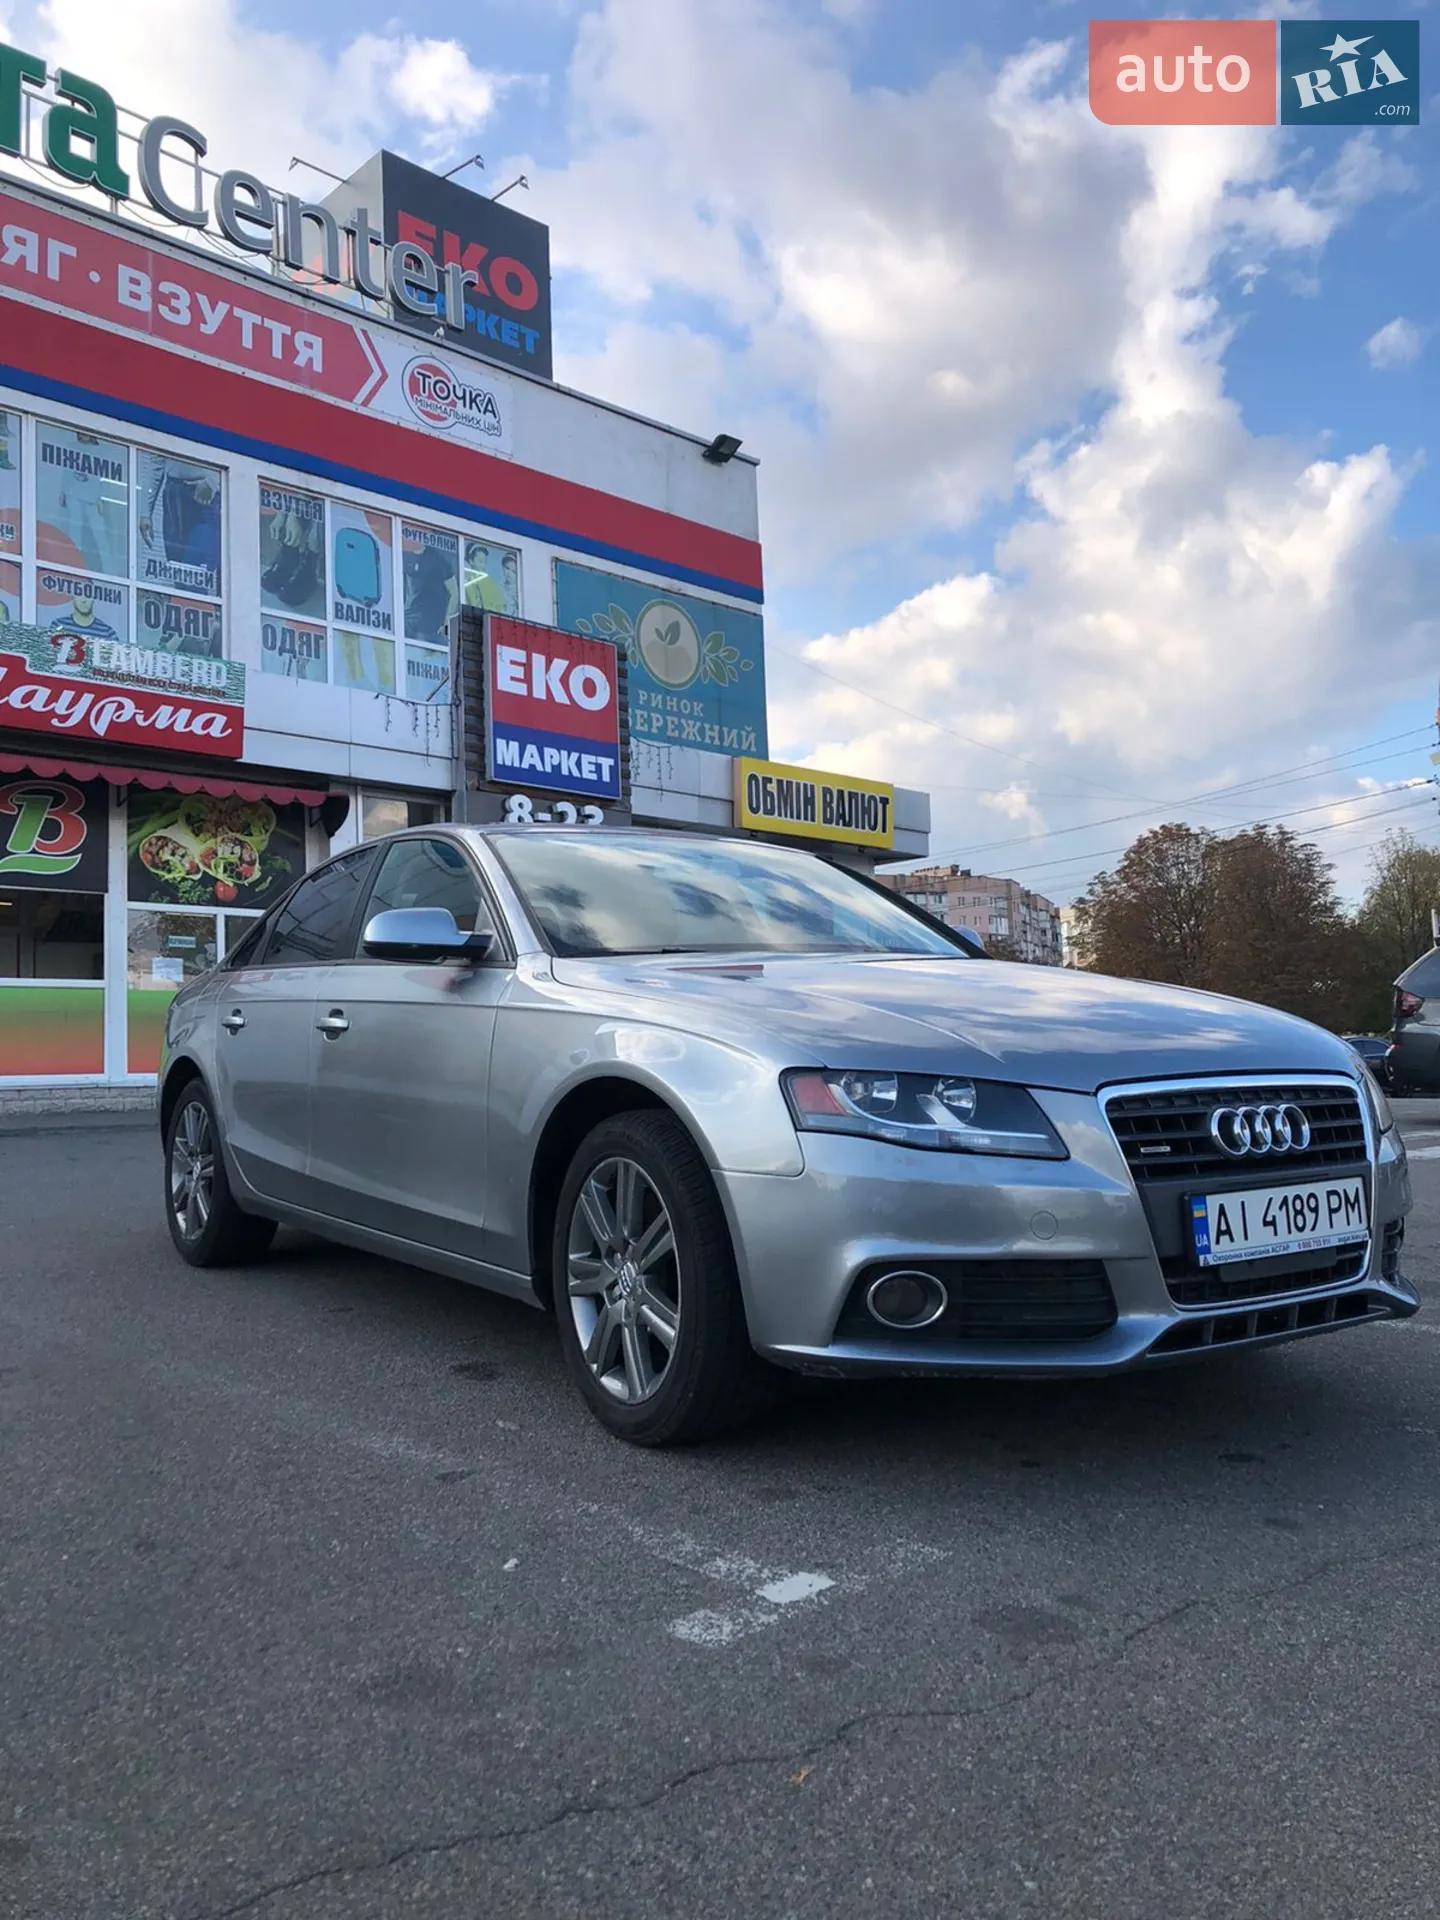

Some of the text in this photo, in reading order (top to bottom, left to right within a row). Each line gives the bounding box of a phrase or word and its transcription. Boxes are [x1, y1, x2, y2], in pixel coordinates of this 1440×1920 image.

[397, 210, 539, 311] ЕКО
[117, 263, 324, 374] ВЗУТТЯ
[414, 396, 482, 427] МІНІМАЛЬНИХ
[416, 370, 498, 420] ТОЧКА
[41, 441, 123, 482] ПІЖАМИ
[260, 487, 324, 521] ВЗУТТЯ
[402, 527, 457, 552] ФУТБОЛКИ
[42, 575, 122, 605] ФУТБОЛКИ
[145, 558, 215, 589] ДЖИНСИ
[144, 600, 214, 638] ОДЯГ
[334, 601, 392, 631] ВАЛІЗИ
[261, 623, 325, 660] ОДЯГ
[496, 643, 611, 711] ЕКО
[0, 666, 232, 738] аурма
[637, 690, 704, 717] РИНОК
[496, 738, 615, 783] МАРКЕТ
[747, 773, 890, 834] ОБМІН ВАЛЮТ
[1215, 1186, 1363, 1245] AI 4189 PM
[1195, 1233, 1209, 1246] UA
